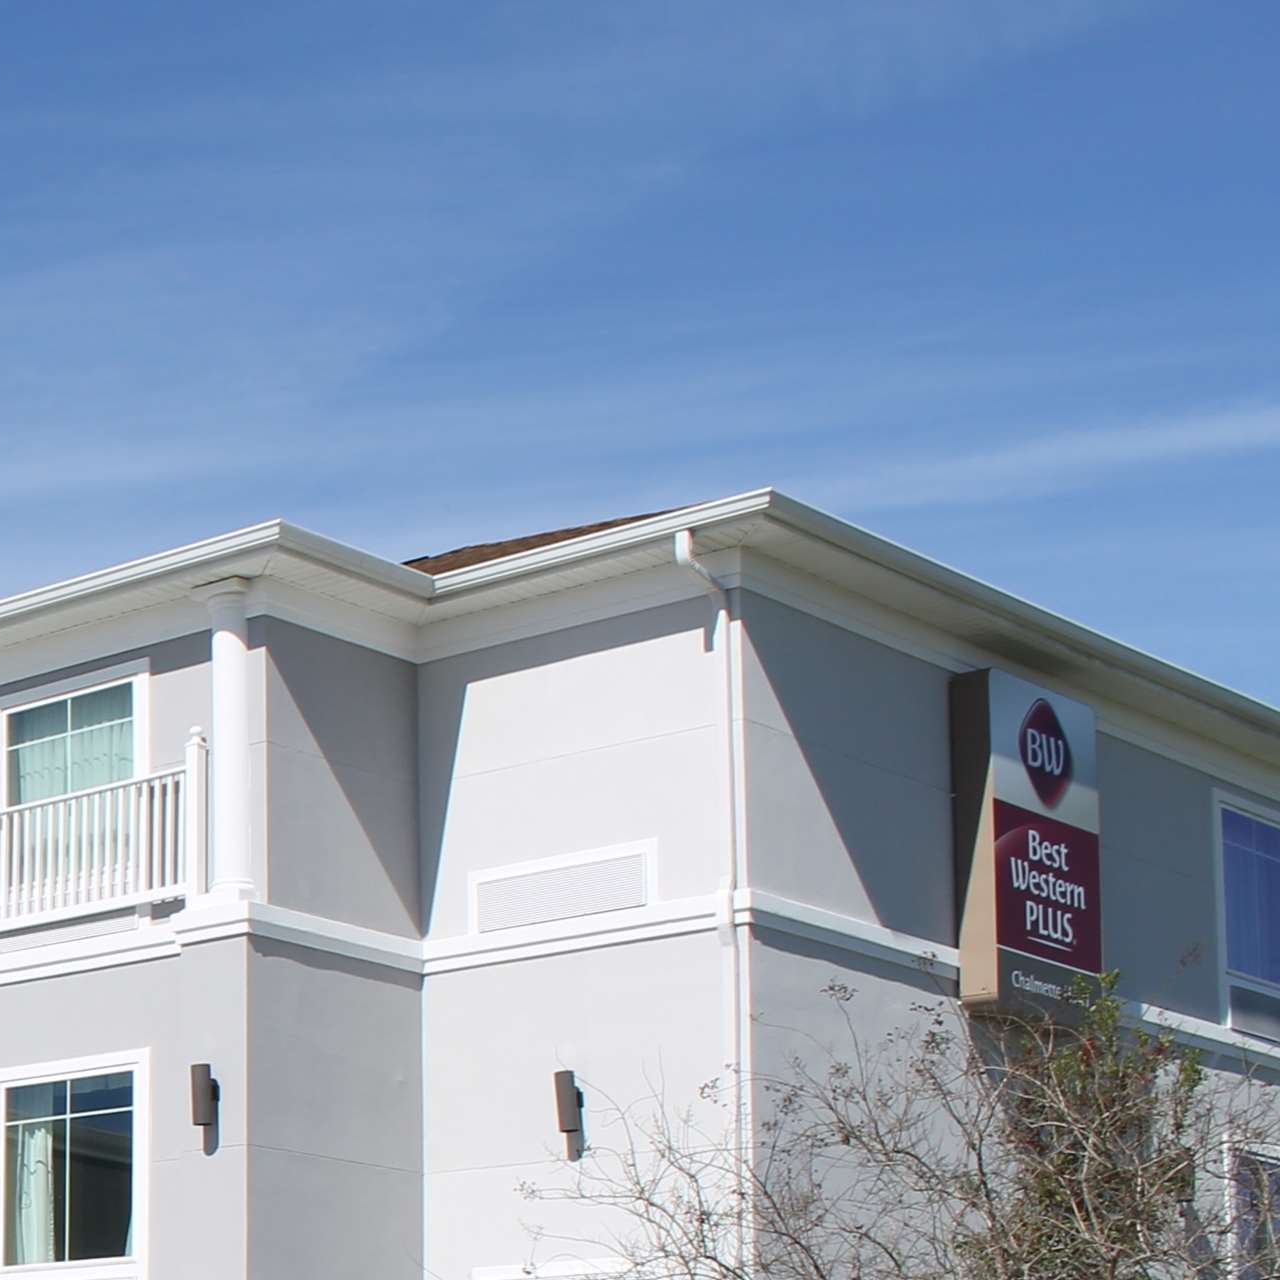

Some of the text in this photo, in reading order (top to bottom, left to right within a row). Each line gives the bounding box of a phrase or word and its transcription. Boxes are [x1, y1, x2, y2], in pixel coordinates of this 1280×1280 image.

[1025, 727, 1064, 776] BW
[1028, 829, 1069, 872] Best
[1010, 856, 1087, 910] Western
[1024, 900, 1073, 943] PLUS
